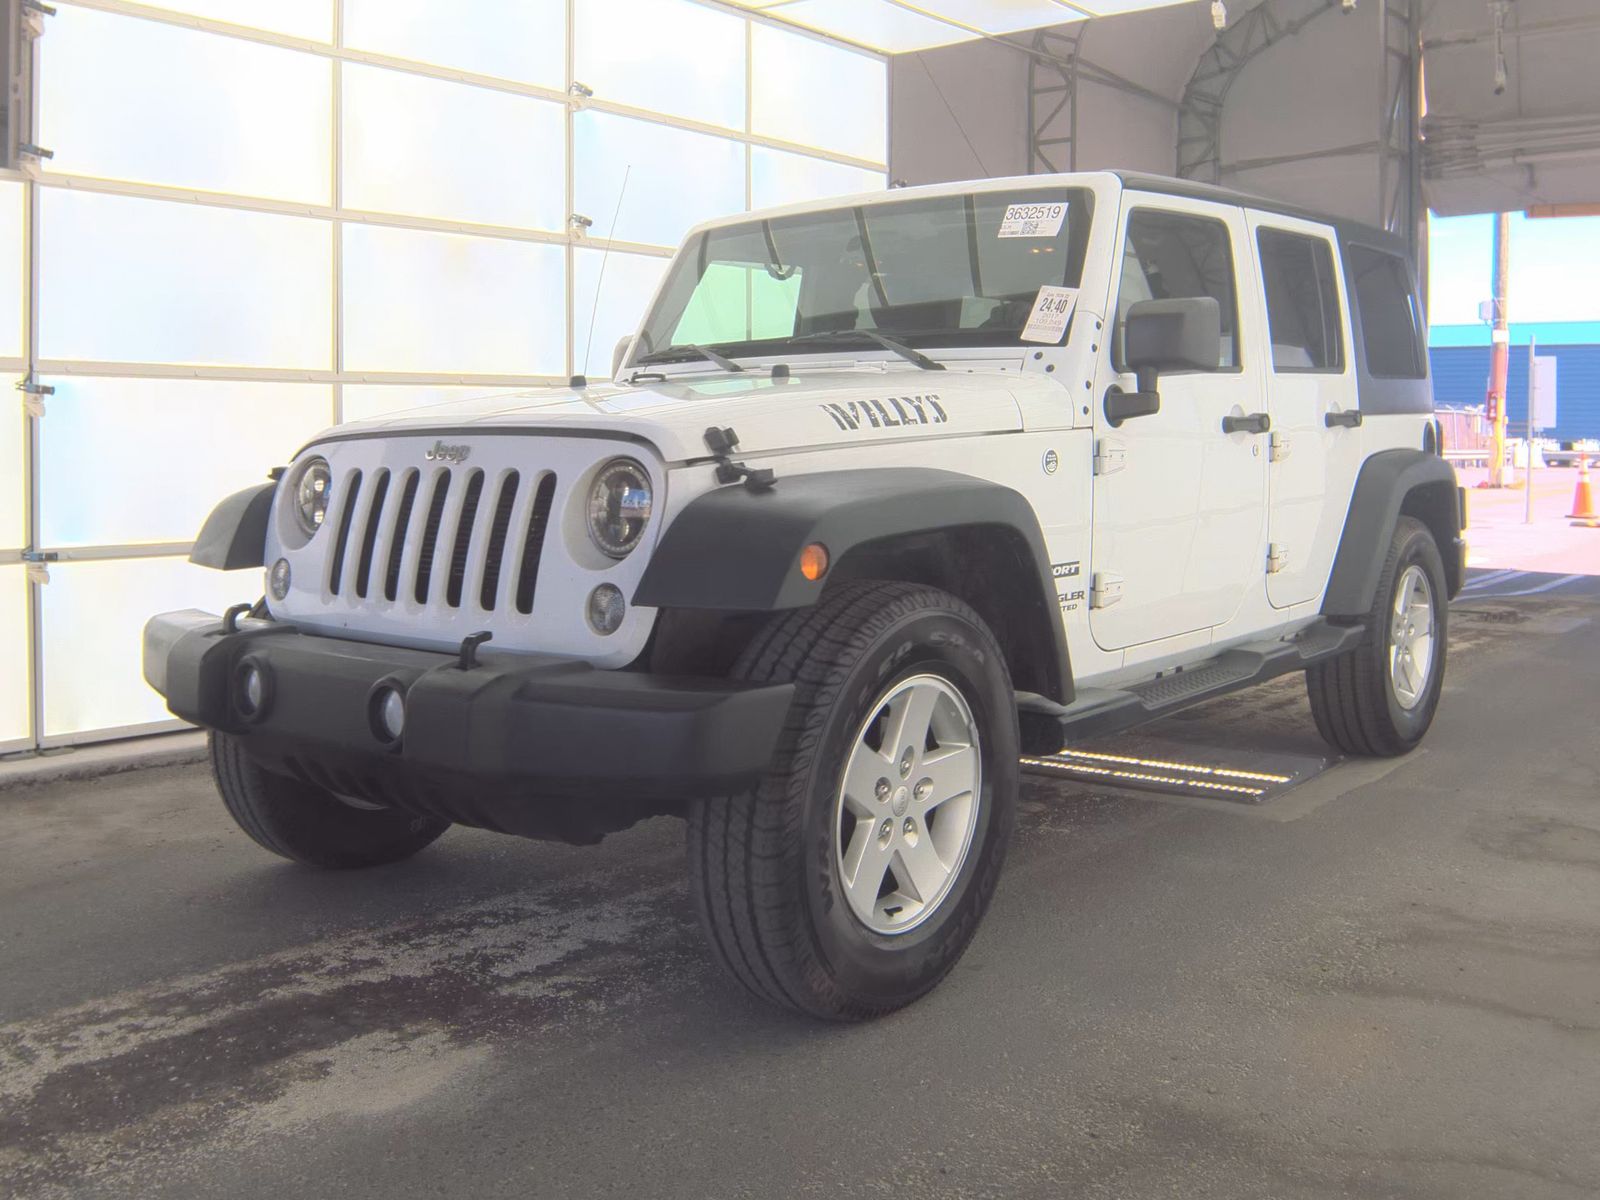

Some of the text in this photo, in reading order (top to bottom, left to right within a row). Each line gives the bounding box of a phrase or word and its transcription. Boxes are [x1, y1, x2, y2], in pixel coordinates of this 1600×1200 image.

[1006, 205, 1061, 220] 3632519
[1040, 298, 1068, 313] 24:40
[818, 395, 948, 431] WILLYS
[424, 439, 471, 465] Jeep
[1052, 564, 1080, 576] ORT
[1057, 590, 1085, 603] GLER
[1061, 603, 1078, 612] TED
